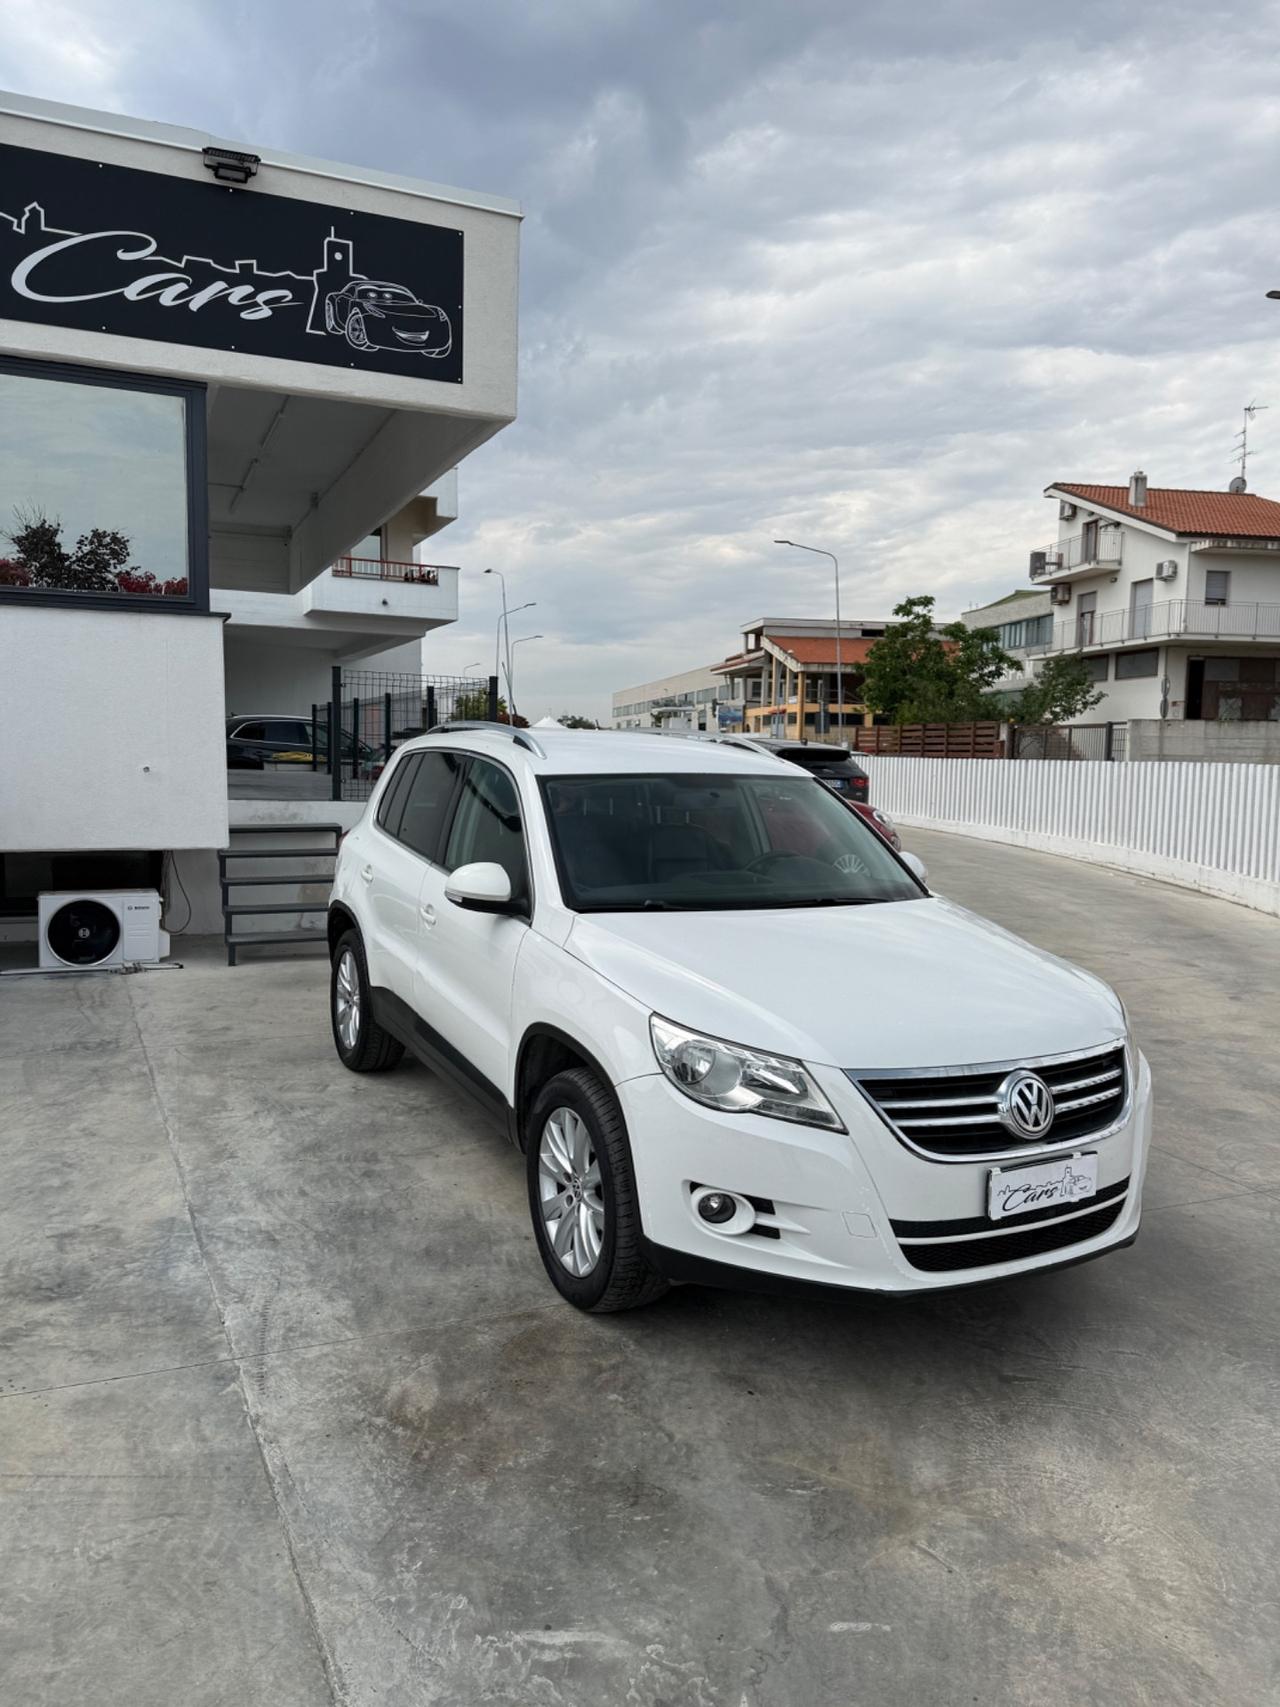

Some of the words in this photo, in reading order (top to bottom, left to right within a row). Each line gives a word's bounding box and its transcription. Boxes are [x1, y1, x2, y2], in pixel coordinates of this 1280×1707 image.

[11, 231, 304, 320] Cars
[1012, 1079, 1047, 1126] VW
[1002, 1184, 1058, 1211] Cars
